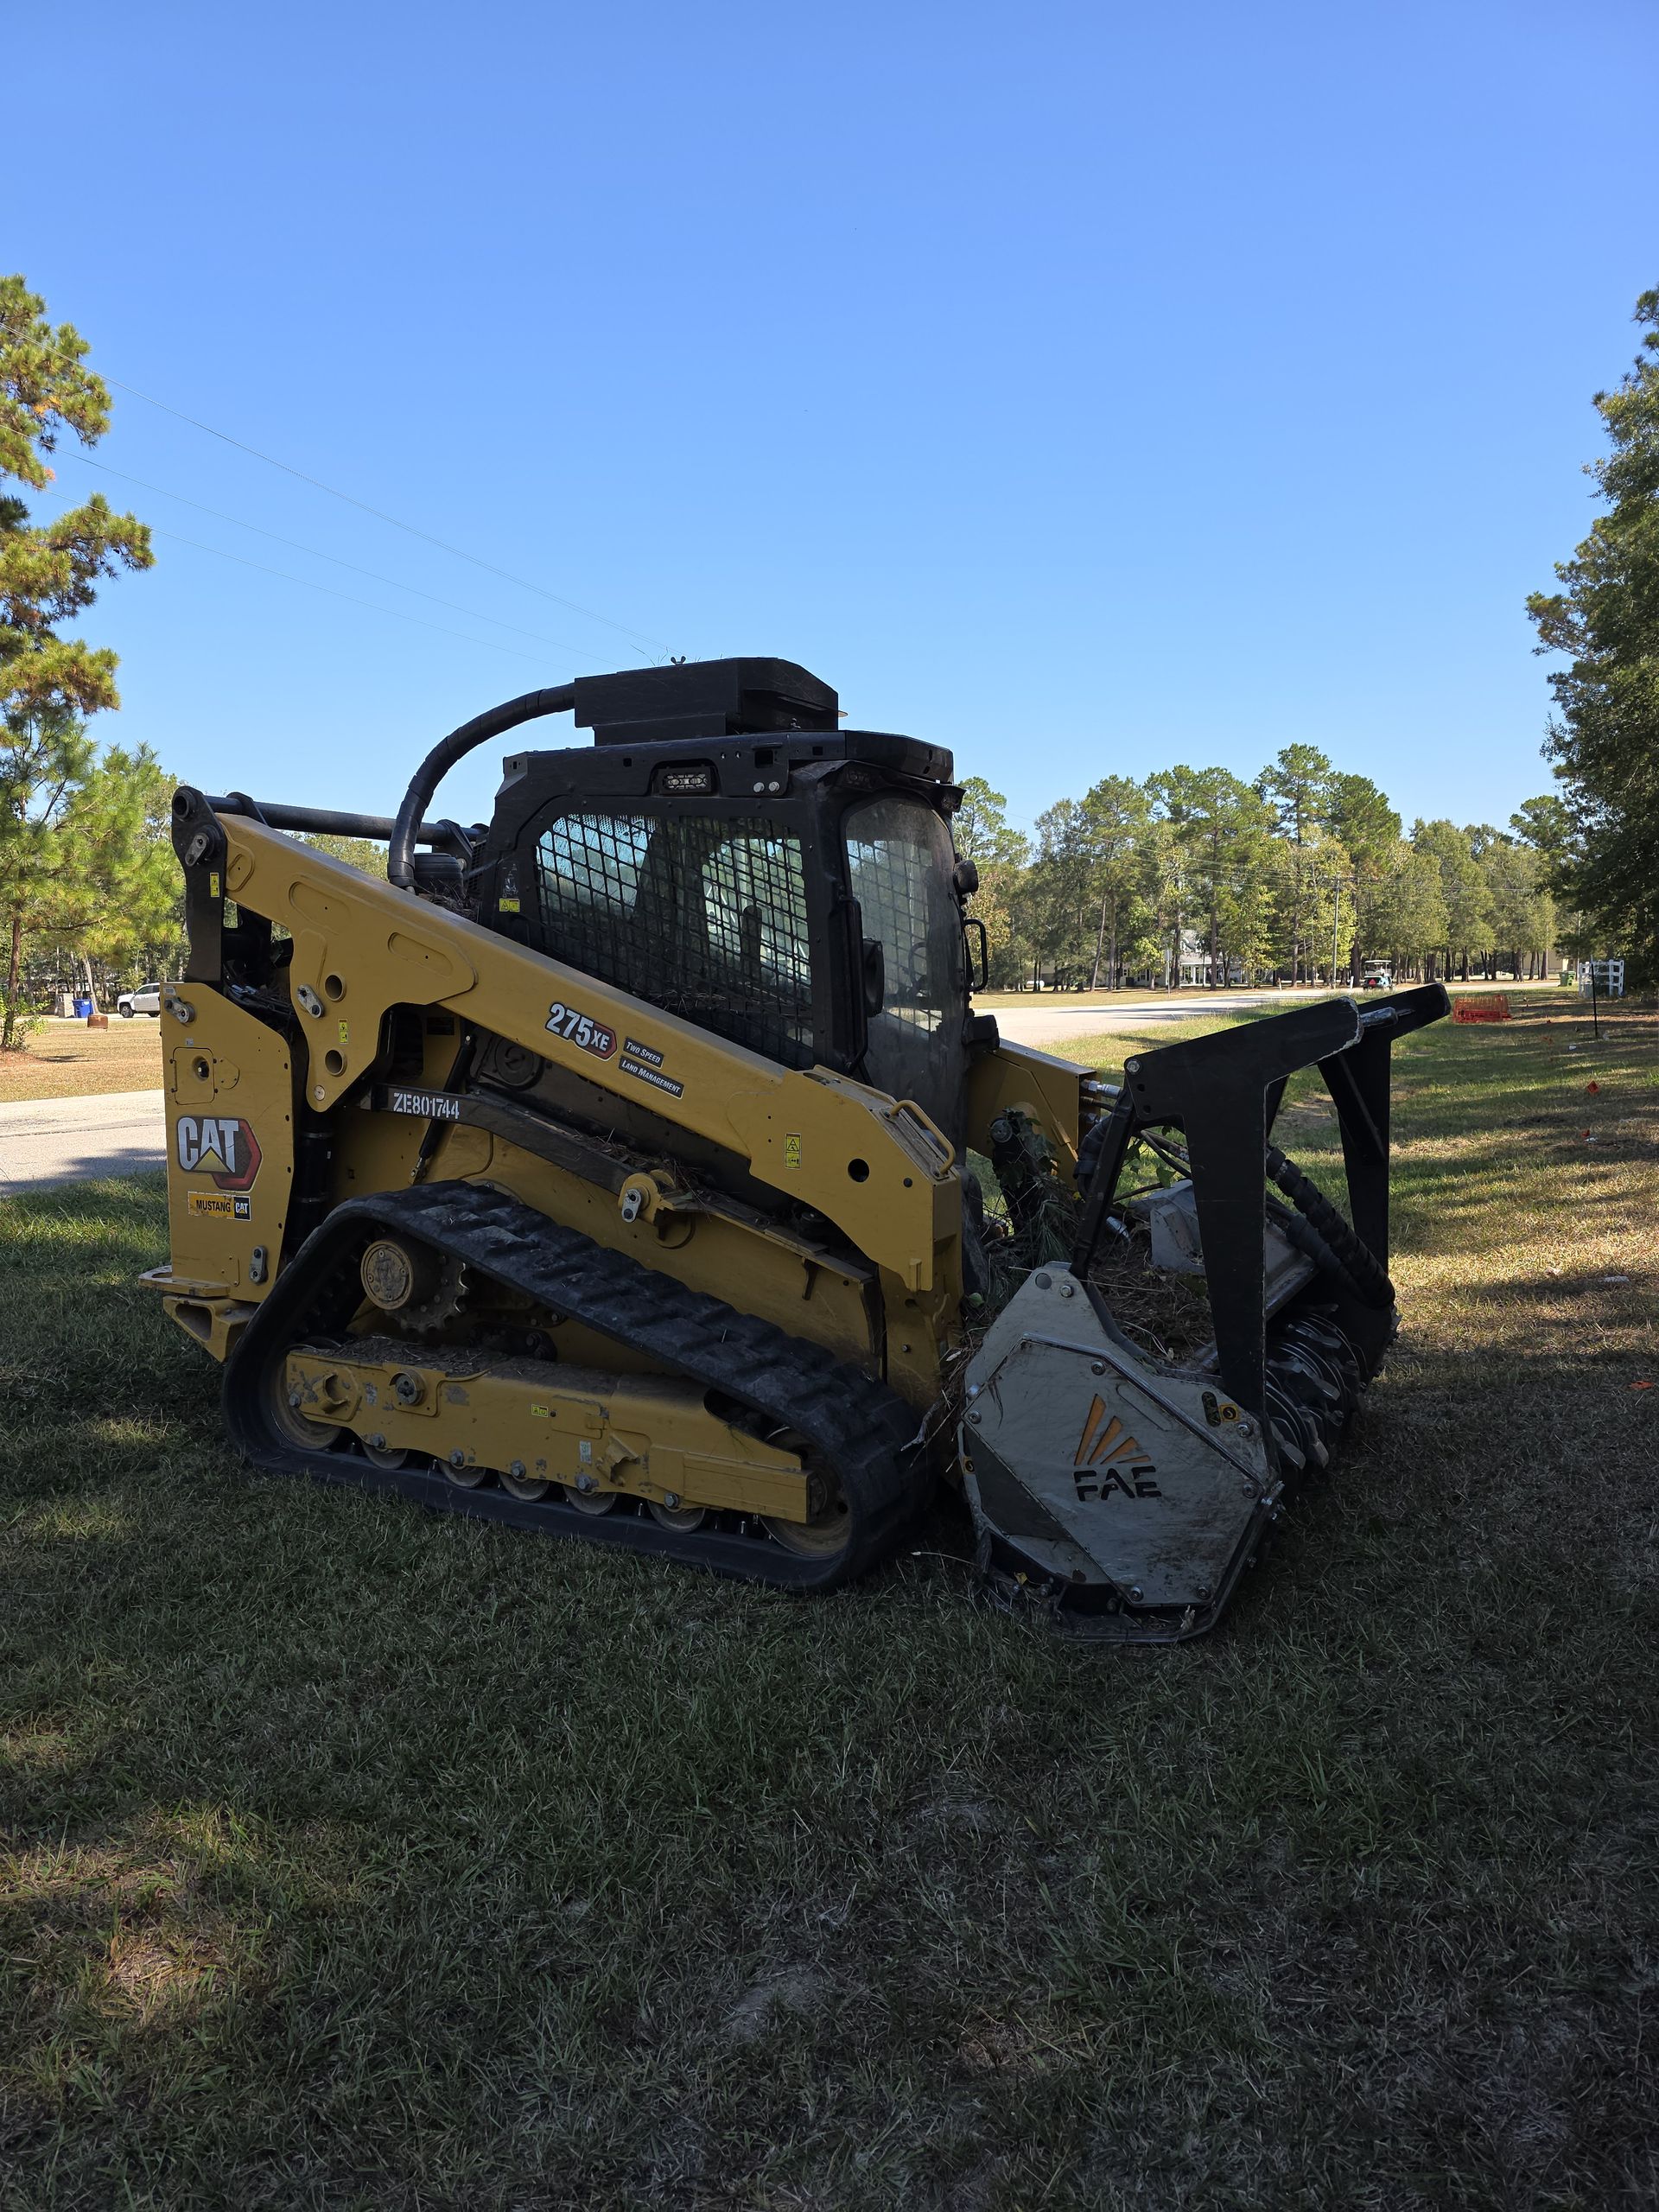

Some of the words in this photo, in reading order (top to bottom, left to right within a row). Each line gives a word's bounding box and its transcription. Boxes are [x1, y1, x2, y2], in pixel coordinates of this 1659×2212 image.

[626, 1041, 640, 1054] TWO
[640, 1048, 661, 1064] SPEED
[621, 1059, 638, 1074] LAND
[638, 1067, 681, 1094] MANAGEMENT
[393, 1092, 460, 1119] ZE801744
[177, 1116, 239, 1173] CAT
[196, 1199, 231, 1213] MUSTANG
[235, 1202, 248, 1215] CAT
[1073, 1465, 1162, 1502] FAE
